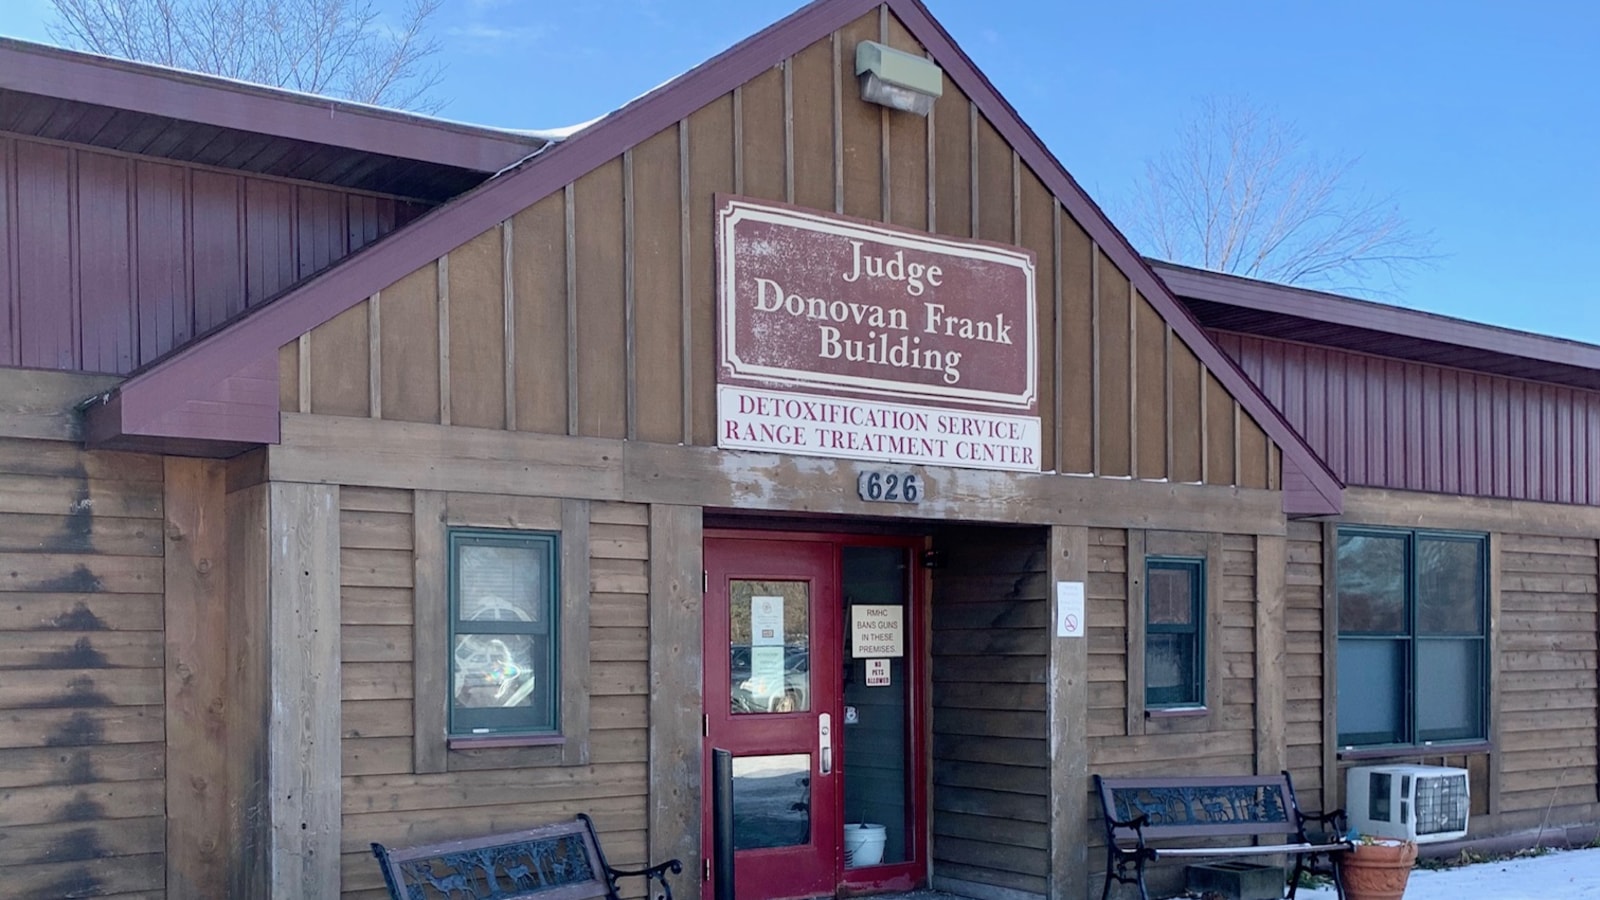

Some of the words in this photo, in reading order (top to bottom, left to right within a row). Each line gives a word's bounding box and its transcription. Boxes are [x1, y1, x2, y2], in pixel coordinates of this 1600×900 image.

[842, 241, 943, 297] Judge
[753, 277, 909, 331] Donovan
[924, 302, 1013, 345] Frank
[818, 325, 962, 385] Building
[738, 394, 928, 433] DETOXIFICATION
[937, 414, 1026, 441] SERVICE/
[725, 419, 807, 446] RANGE
[815, 428, 949, 459] TREATMENT
[955, 440, 1034, 465] CENTER
[867, 472, 918, 501] 626
[857, 620, 876, 630] BANS
[877, 620, 898, 630] GUNS
[866, 608, 888, 617] RMHC
[861, 633, 869, 642] IN
[870, 632, 894, 642] THESE
